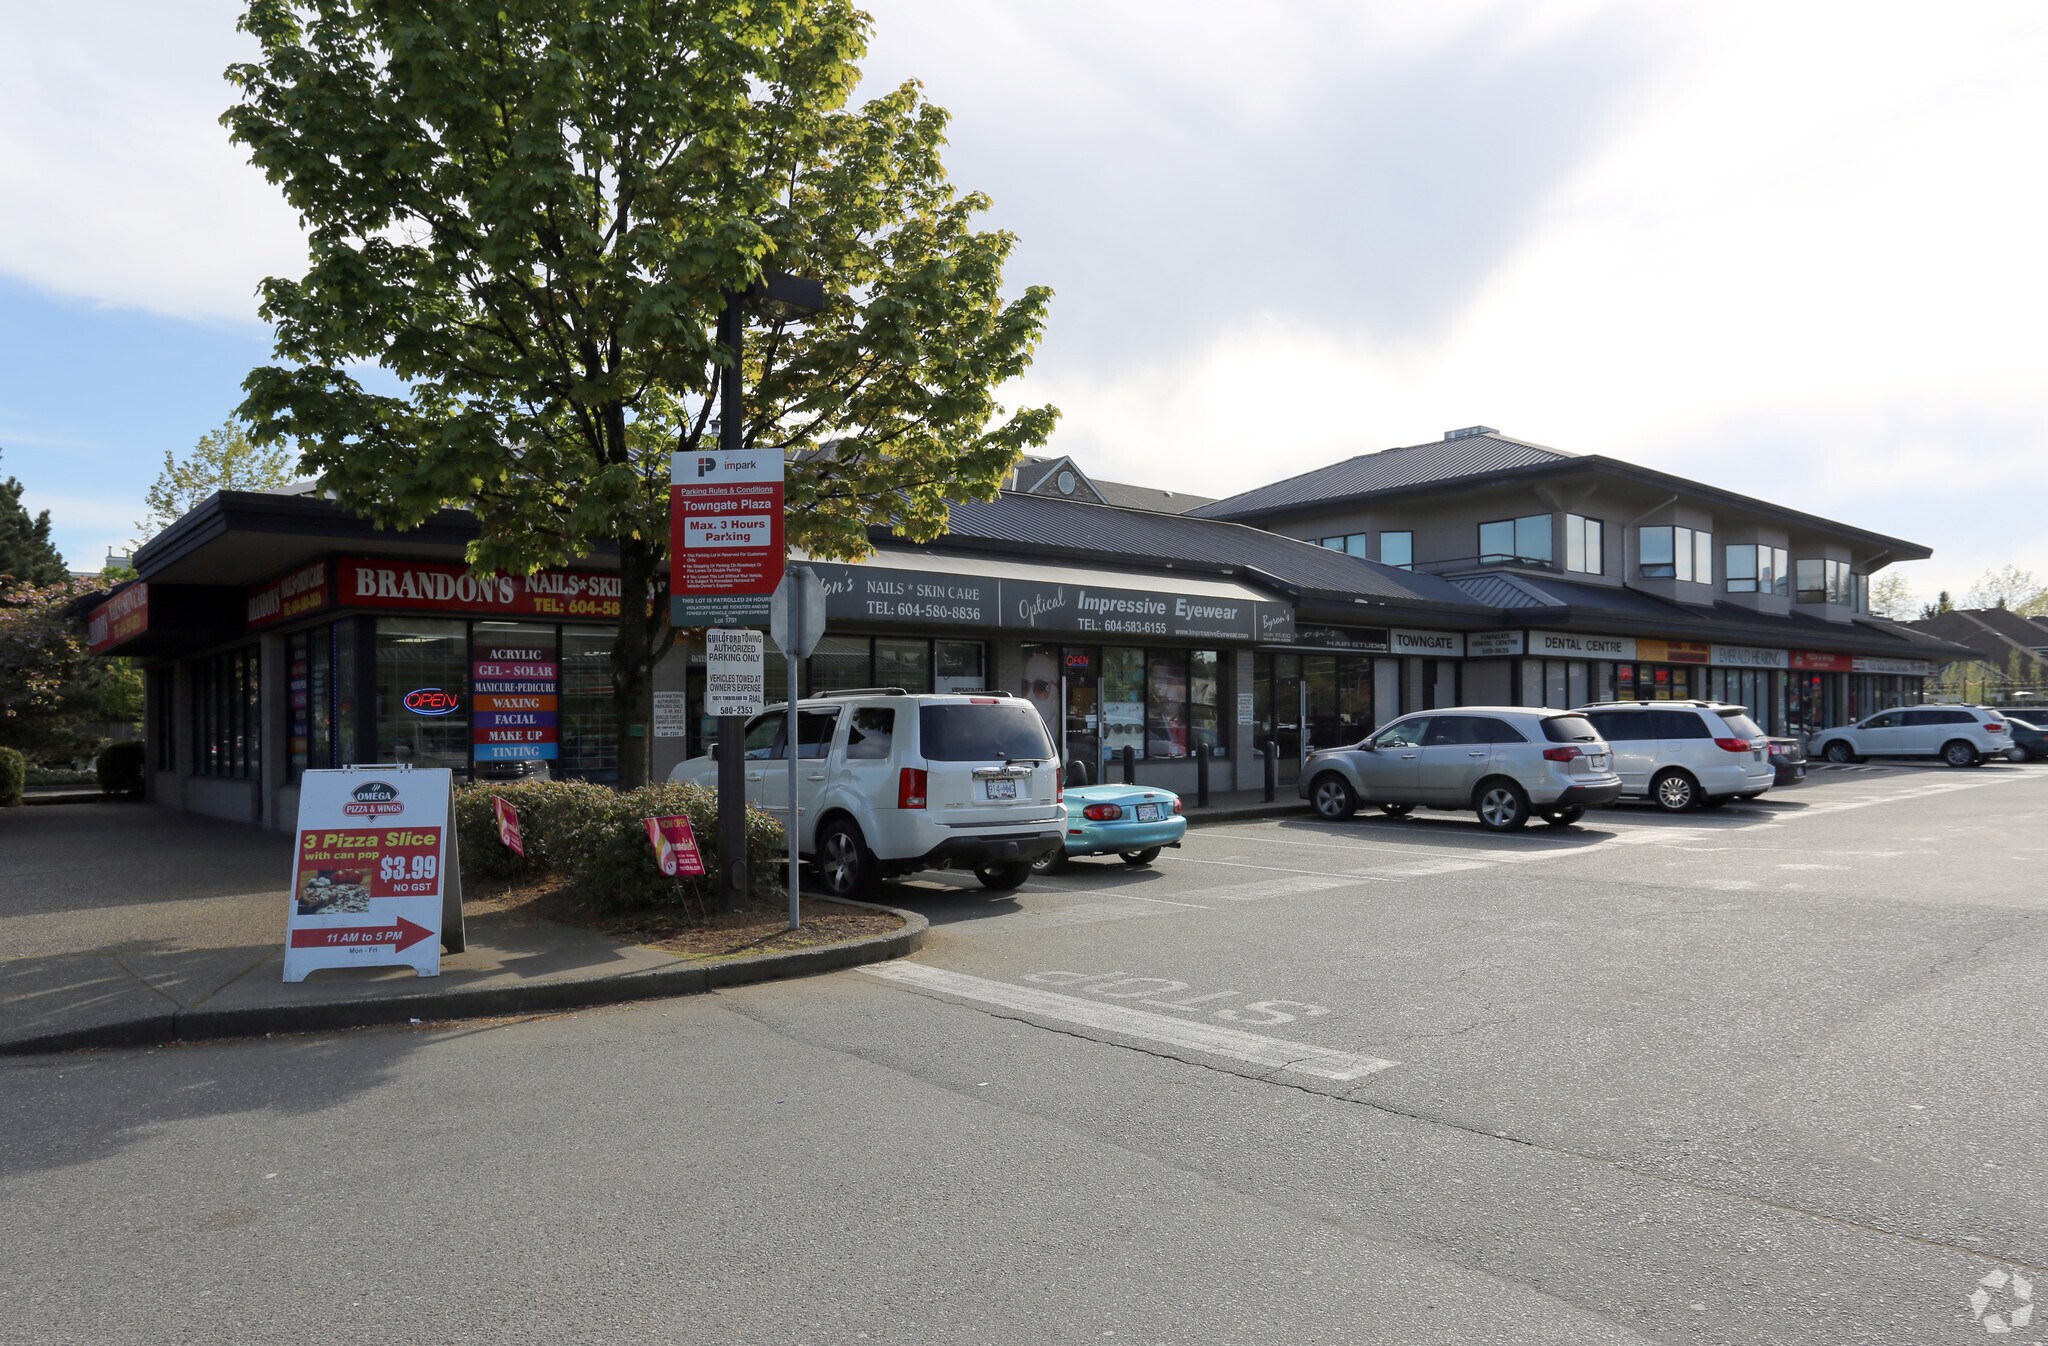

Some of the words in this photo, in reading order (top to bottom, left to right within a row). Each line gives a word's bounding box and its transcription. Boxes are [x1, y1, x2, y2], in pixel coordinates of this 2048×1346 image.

[724, 460, 757, 471] impark
[681, 488, 706, 497] Parking
[736, 486, 774, 494] Conditions
[683, 500, 738, 513] Towngate
[741, 499, 772, 510] Plaza
[690, 521, 717, 530] Max.
[720, 520, 728, 529] 3
[731, 520, 765, 529] Hours
[705, 532, 751, 543] Parking
[355, 567, 515, 606] BRANDON'S
[866, 580, 905, 596] NAILS
[916, 582, 946, 600] SKIN
[947, 586, 980, 602] CARE
[534, 598, 564, 615] TEL:
[866, 600, 894, 617] TEL:
[897, 602, 980, 621] 604-580-8836
[1019, 585, 1067, 628] Optical
[1078, 590, 1167, 617] Impressive
[1175, 598, 1238, 621] Eyewear
[1078, 618, 1102, 632] TEL:
[1104, 620, 1167, 634] 604-583-6155
[1262, 610, 1290, 632] Byron's
[708, 634, 742, 643] GUILDFORD
[742, 634, 762, 644] TOWING
[1326, 640, 1352, 648] HAIR
[1352, 642, 1387, 650] STUDIO
[1396, 634, 1454, 651] TOWNGATE
[1545, 636, 1582, 651] DENTAL
[1586, 640, 1622, 653] CENTRE
[489, 648, 542, 660] ACRYLIC
[714, 644, 756, 653] AUTHORIZED
[708, 654, 741, 662] PARKING
[742, 654, 761, 662] ONLY
[1066, 655, 1089, 667] OPEN
[1720, 648, 1751, 664] EMERALD
[1752, 650, 1780, 666] HEARING
[478, 665, 503, 676] GEL
[514, 666, 553, 678] SOLAR
[710, 674, 735, 683] VEHICLES
[736, 674, 754, 683] TOWED
[755, 674, 762, 683] AT
[710, 684, 736, 692] OWNER'S
[737, 684, 762, 692] EXPENSE
[406, 692, 458, 708] OPEN
[492, 698, 540, 708] WAXING
[720, 706, 753, 715] 580-2353
[494, 714, 537, 725] FACIAL
[488, 731, 523, 742] MAKE
[527, 730, 543, 741] UP
[492, 746, 539, 758] TINTING
[357, 792, 392, 801] OMEGA
[346, 805, 368, 814] PIZZA
[370, 805, 376, 813] &
[377, 804, 401, 813] WINGS
[304, 834, 317, 850] 3
[322, 833, 379, 849] Pizza
[384, 831, 436, 848] Slice
[304, 851, 330, 860] with
[334, 852, 355, 860] can
[358, 851, 380, 861] pop
[380, 854, 437, 884] $3.99
[393, 884, 408, 892] NO
[411, 883, 432, 892] GST
[326, 933, 338, 942] 11
[340, 933, 359, 942] AM
[362, 933, 373, 942] to
[375, 932, 382, 941] 5
[384, 931, 403, 940] PM
[1024, 970, 1331, 1026] STOP
